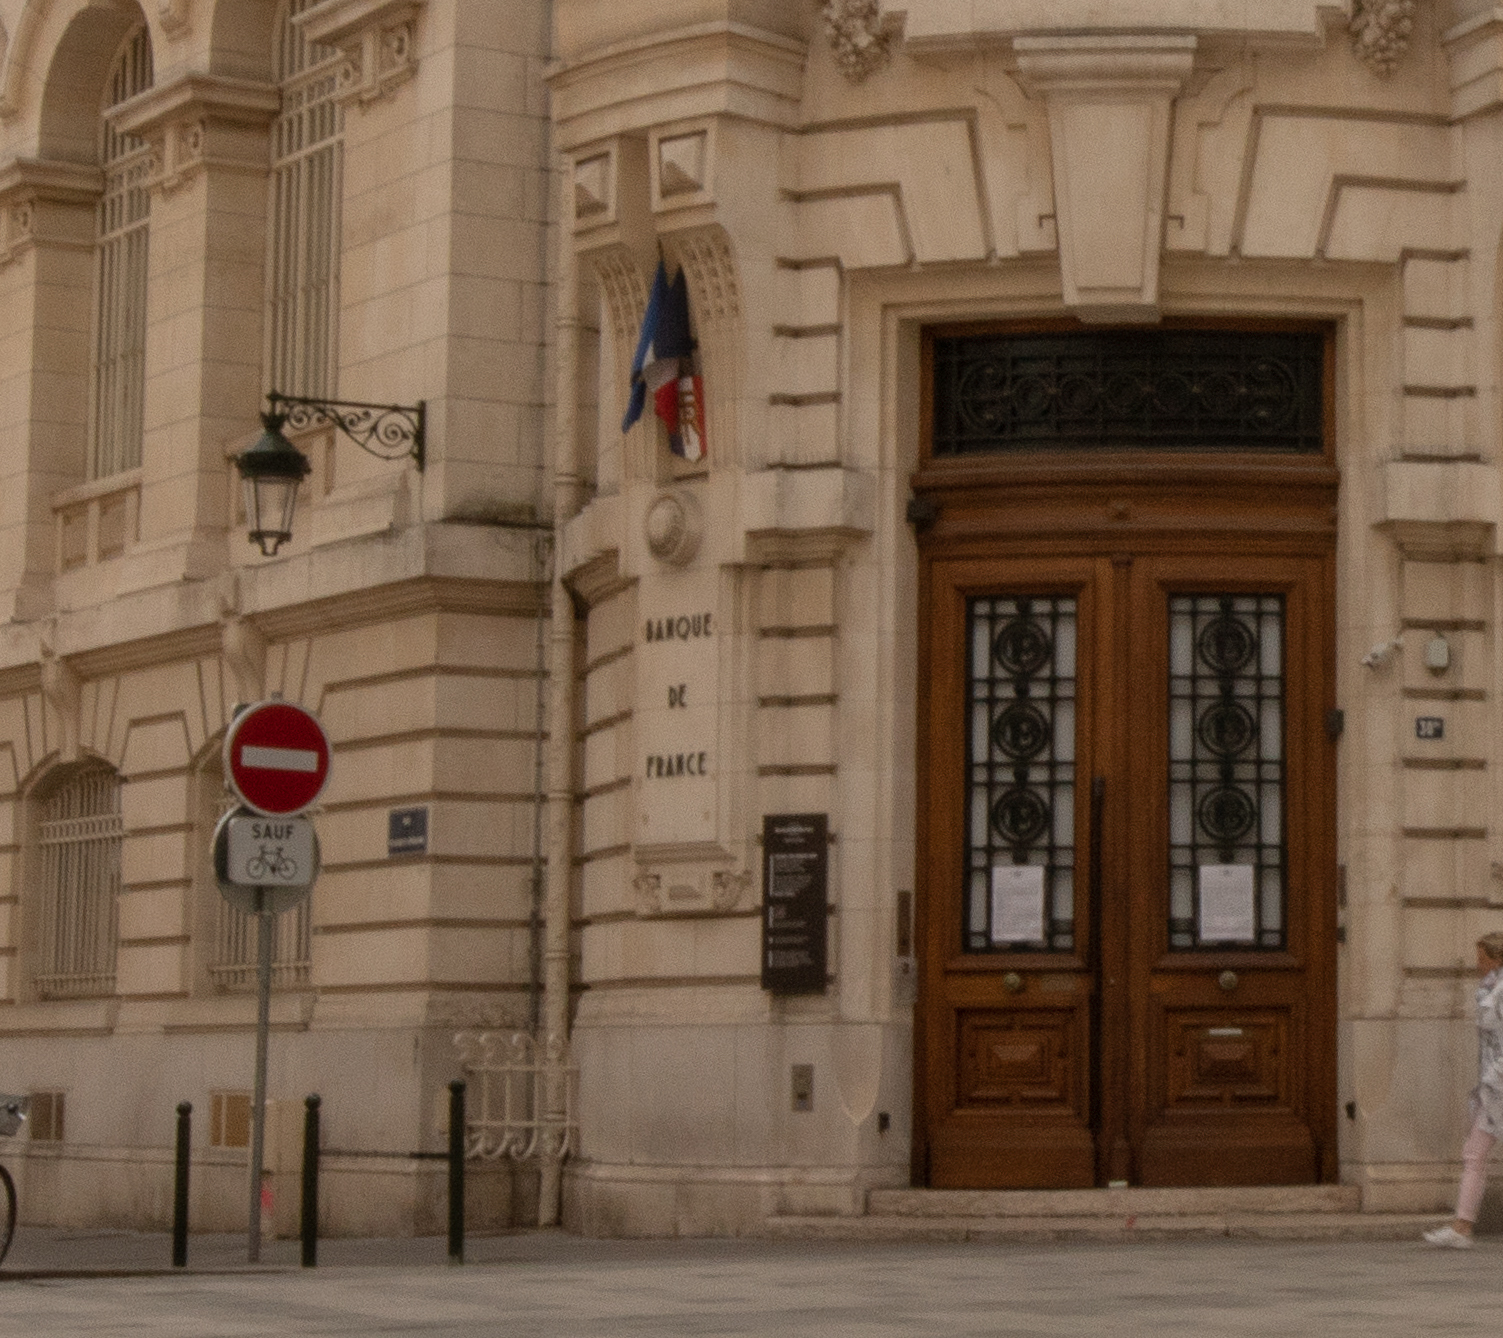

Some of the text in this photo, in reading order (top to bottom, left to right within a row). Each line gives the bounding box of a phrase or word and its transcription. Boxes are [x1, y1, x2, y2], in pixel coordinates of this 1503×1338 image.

[645, 611, 713, 643] BANQUE
[667, 683, 688, 710] DE
[646, 751, 708, 779] FRANCE
[251, 823, 295, 841] SAUF
